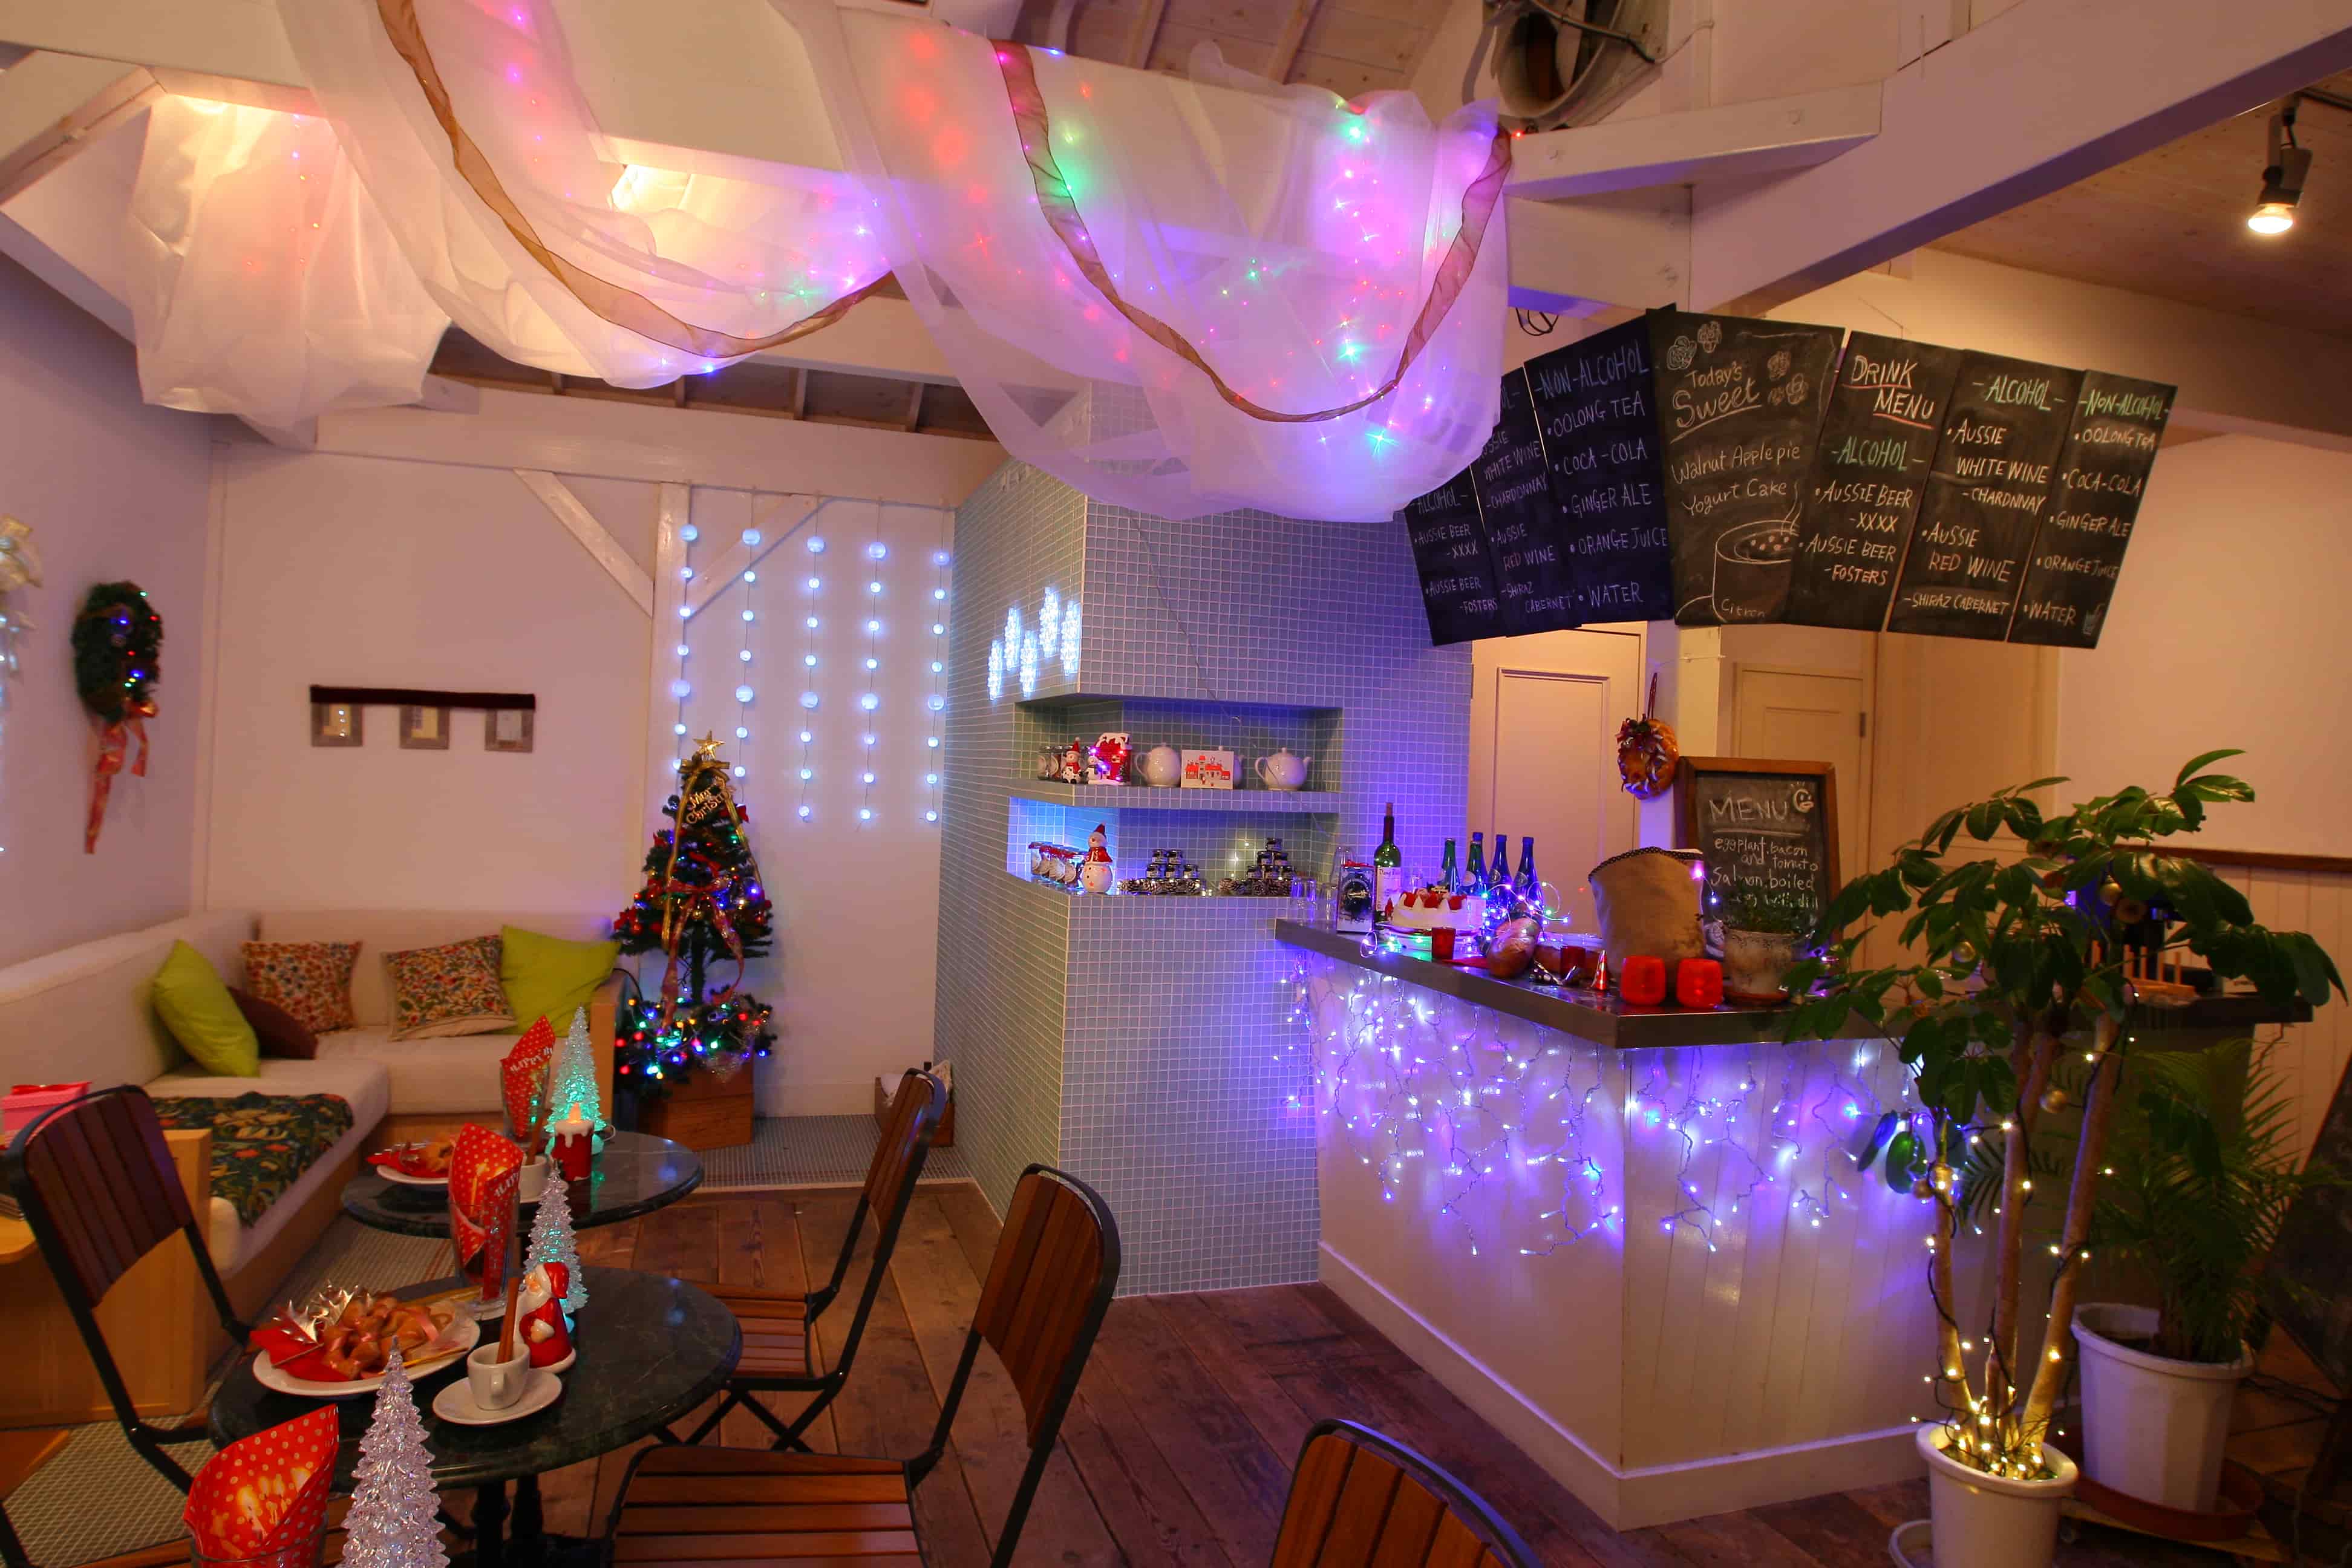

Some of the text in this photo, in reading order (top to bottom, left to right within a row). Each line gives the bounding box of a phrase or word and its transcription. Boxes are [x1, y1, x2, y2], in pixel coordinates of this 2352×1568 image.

[1685, 361, 1742, 388] Today's
[1851, 354, 1918, 389] DRINK
[1553, 390, 1645, 437] OOLONG TEA
[1673, 377, 1760, 428] Sweet
[1873, 387, 1934, 419] MENU
[1952, 417, 2007, 445] AUSSIE
[2083, 426, 2156, 451] OOLONG TEA
[1484, 441, 1541, 482] WHITE WINE
[1671, 440, 1800, 484] Walnut Apple pie
[1956, 457, 2050, 484] WHITE WINE
[1572, 483, 1652, 518] GINGER ALE
[1681, 479, 1786, 515] Yogurt Cake
[1819, 479, 1913, 508] AUSSIE BEER
[1418, 524, 1471, 545] AUSSIE BEER
[1497, 523, 1527, 547] AUSSIE
[1926, 521, 1980, 547] AUSSIE
[2057, 511, 2132, 537] GINGER ALE
[1578, 528, 1668, 555] ORANGE JUICE
[1805, 533, 1896, 561] AUSSIE BEER
[1503, 546, 1555, 571] RED WINE
[1929, 547, 2016, 583] RED WINE
[2044, 554, 2092, 573] ORANGE
[1429, 577, 1481, 596] AUSSIE BEER
[1587, 581, 1644, 607] WATER
[2029, 599, 2077, 627] WATER
[1709, 790, 1789, 823] MENU
[1741, 852, 1764, 865] and
[1771, 841, 1808, 857] bacon
[1769, 869, 1814, 890] boiled
